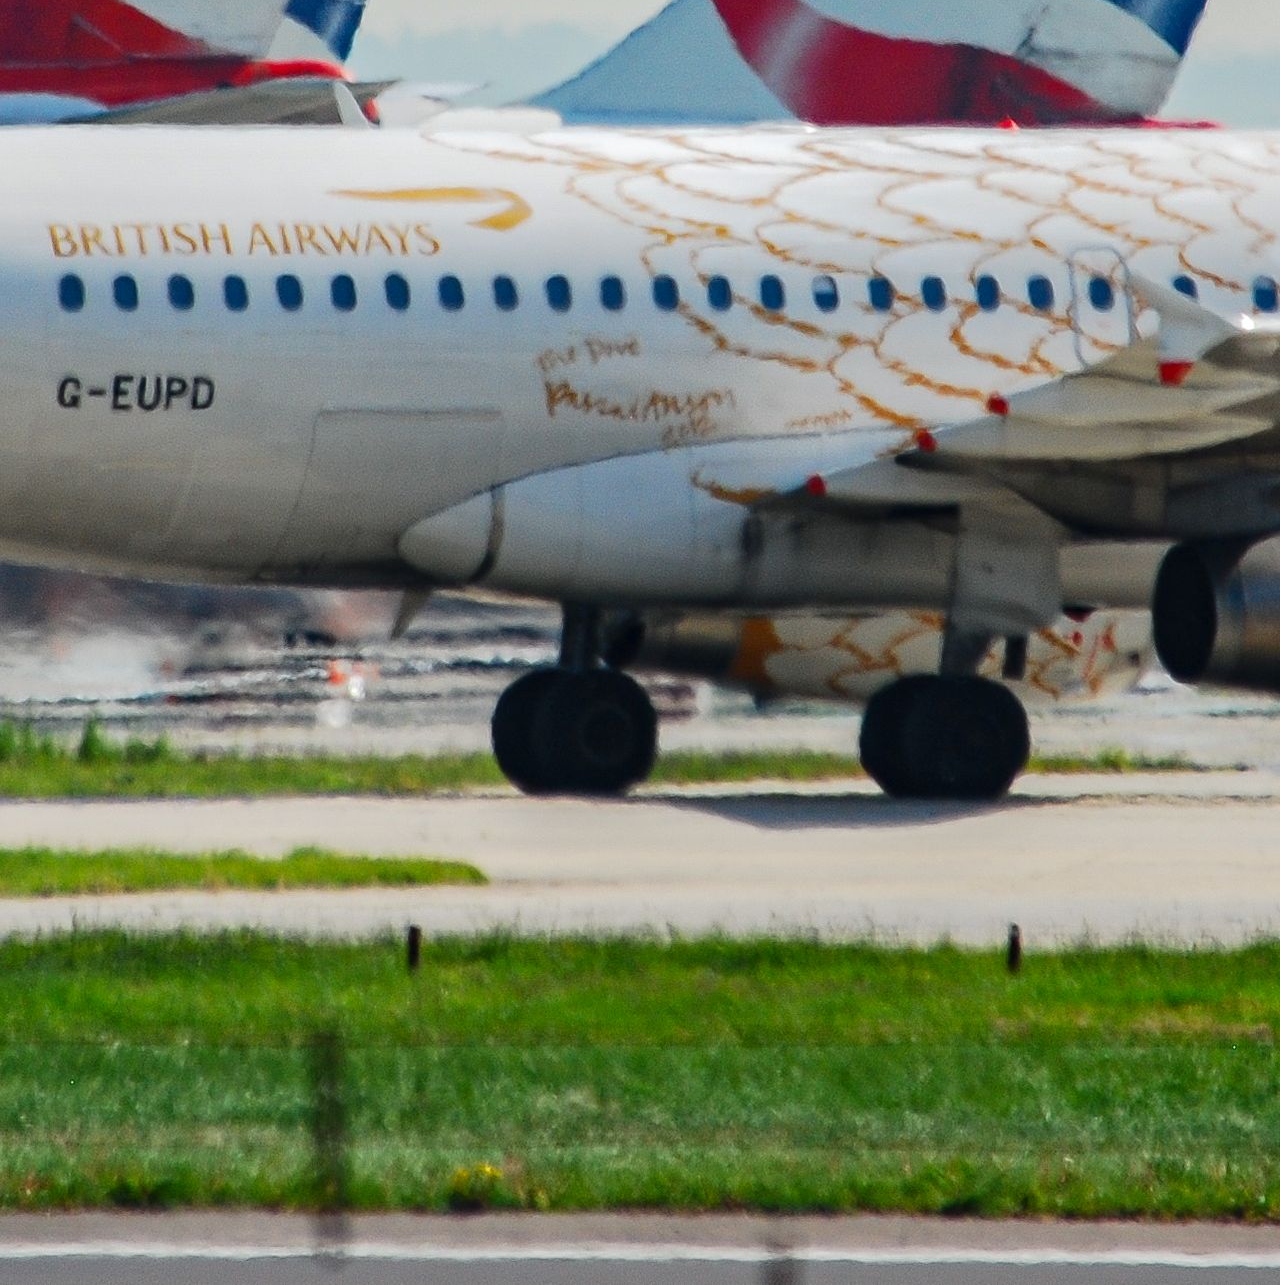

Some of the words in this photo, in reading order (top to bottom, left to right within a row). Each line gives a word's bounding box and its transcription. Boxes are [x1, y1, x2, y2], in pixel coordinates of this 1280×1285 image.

[49, 223, 233, 257] BRITISH
[248, 223, 440, 256] AIRWAYS
[56, 374, 215, 411] G-EUPD
